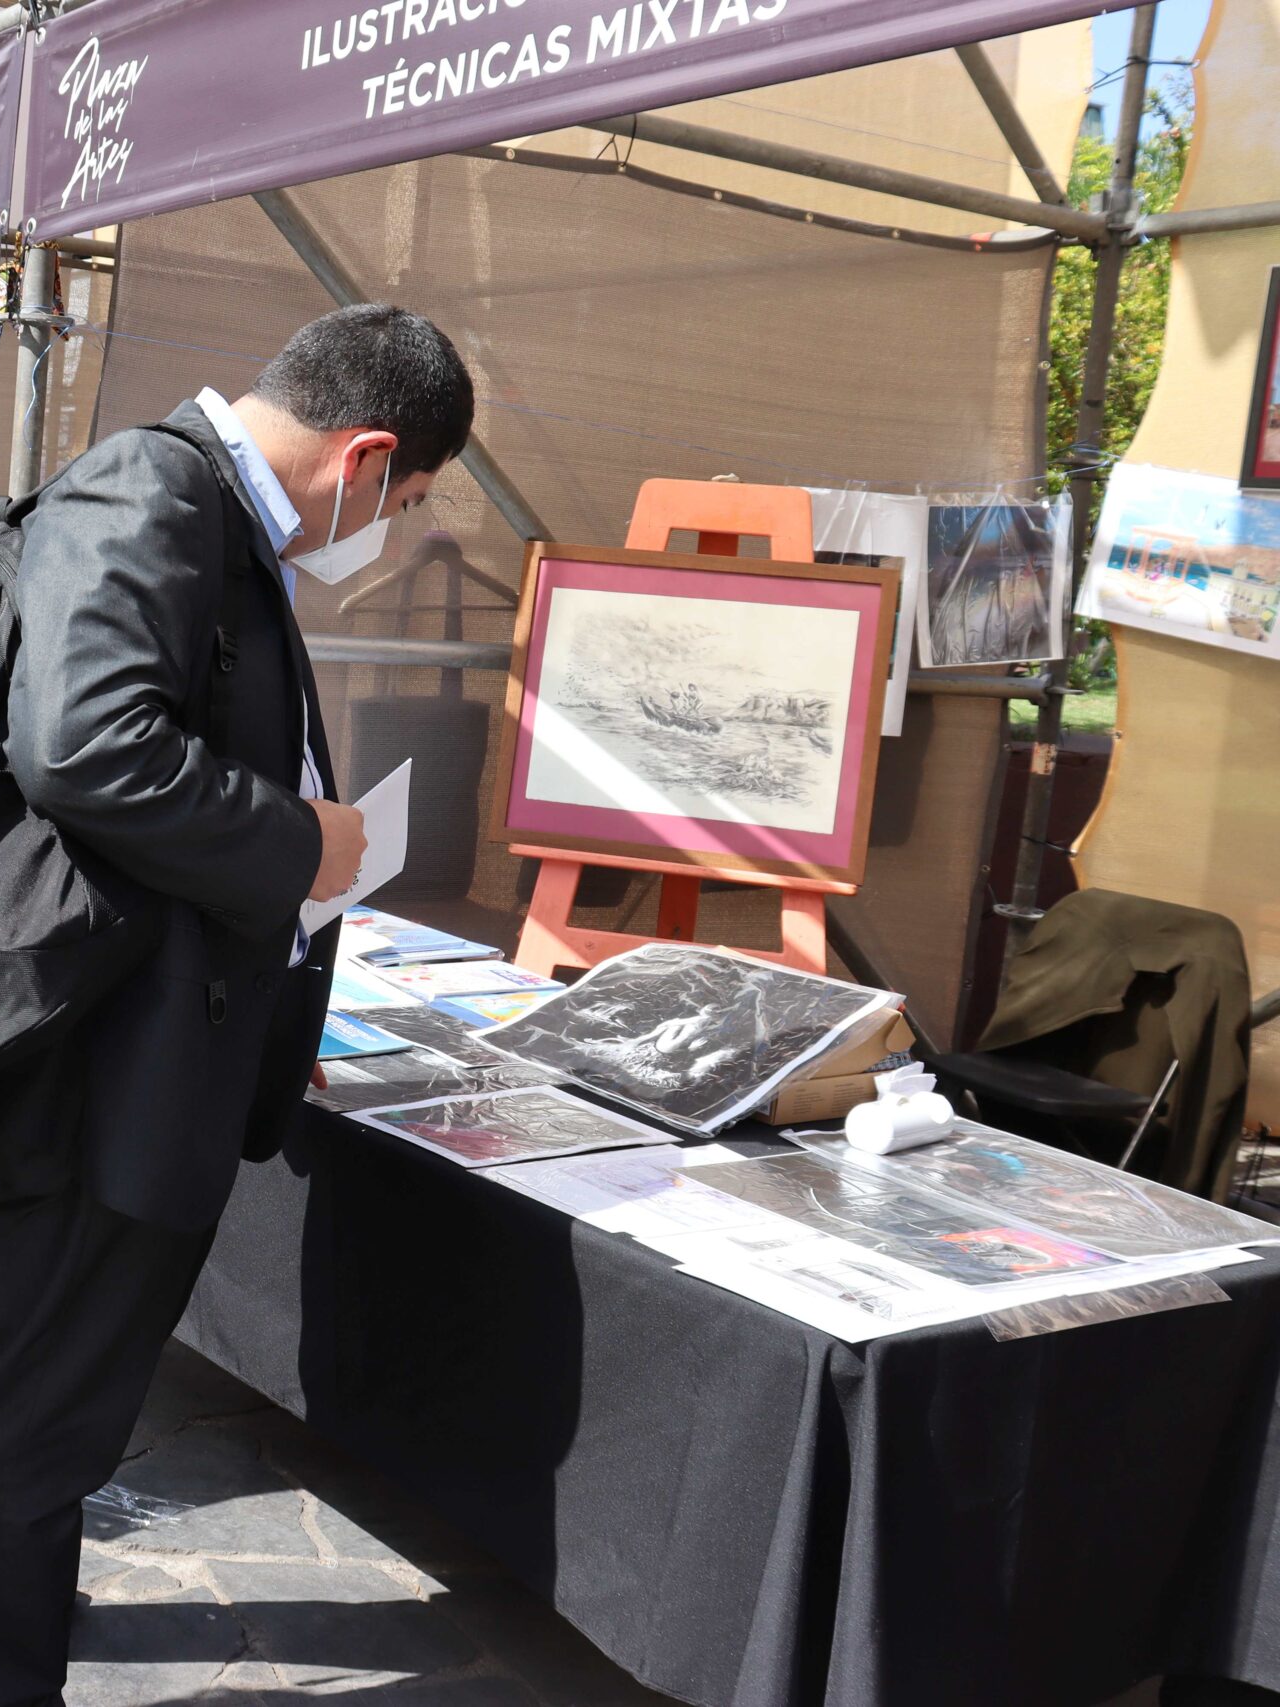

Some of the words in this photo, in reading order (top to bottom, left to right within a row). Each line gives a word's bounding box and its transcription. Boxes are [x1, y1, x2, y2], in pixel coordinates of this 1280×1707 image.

[301, 0, 526, 70] ILUSTRA
[363, 25, 572, 119] TÉCNICAS
[59, 37, 148, 139] Plaza
[74, 109, 93, 144] de
[98, 98, 129, 133] las
[61, 135, 134, 209] Artes
